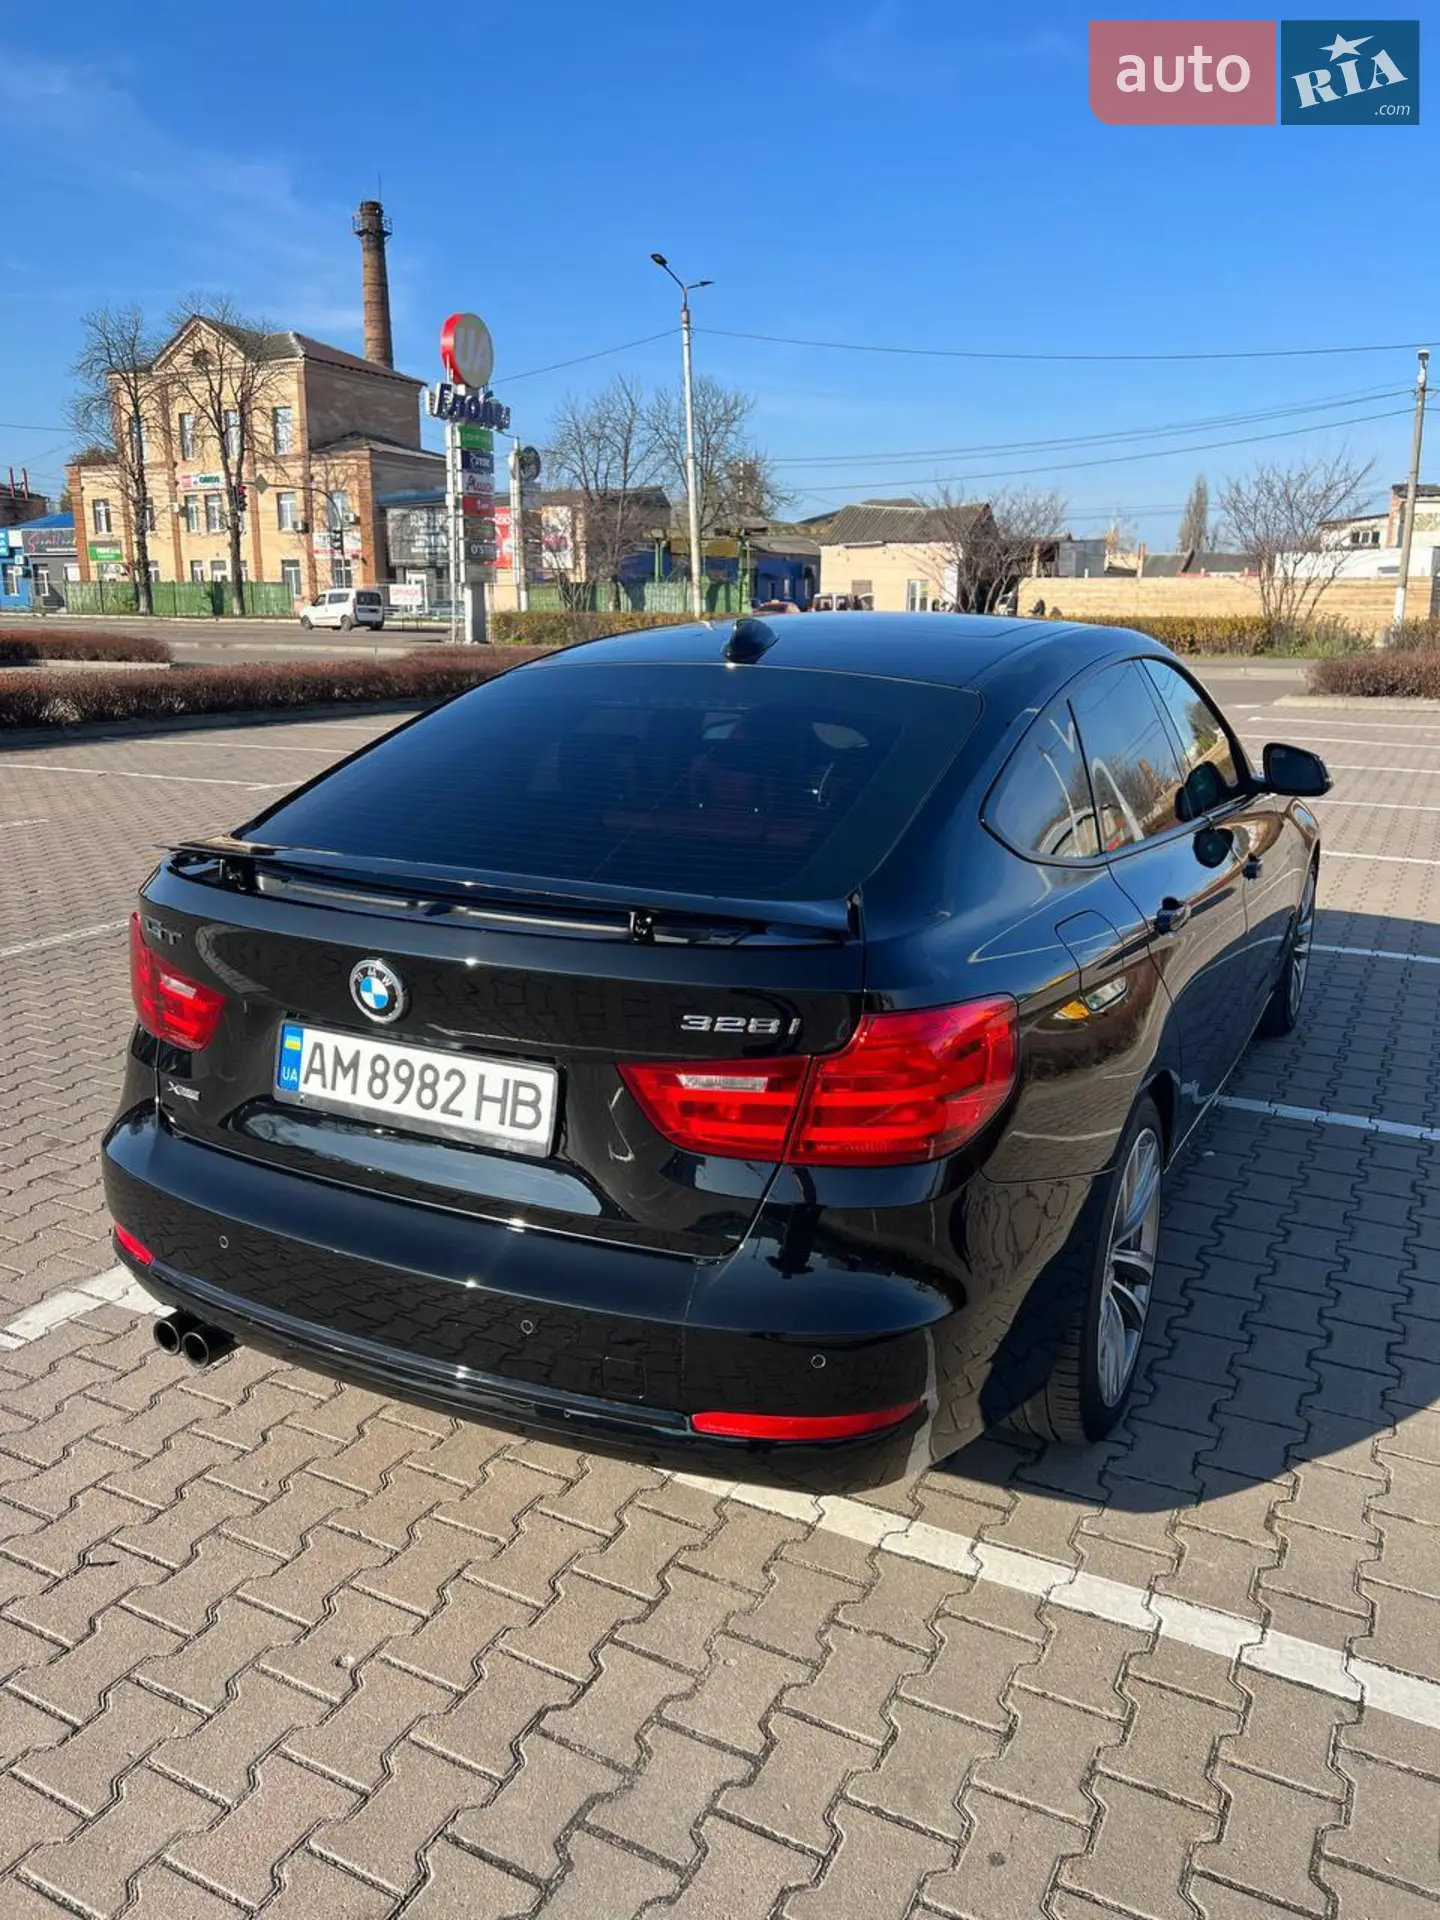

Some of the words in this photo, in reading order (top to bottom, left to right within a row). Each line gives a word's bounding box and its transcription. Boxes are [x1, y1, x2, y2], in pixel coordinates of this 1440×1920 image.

[354, 966, 394, 987] BMW
[679, 1014, 801, 1035] 328i
[282, 1065, 299, 1082] UA
[303, 1041, 361, 1096] AM
[367, 1053, 466, 1118] 8982
[474, 1073, 542, 1130] HB
